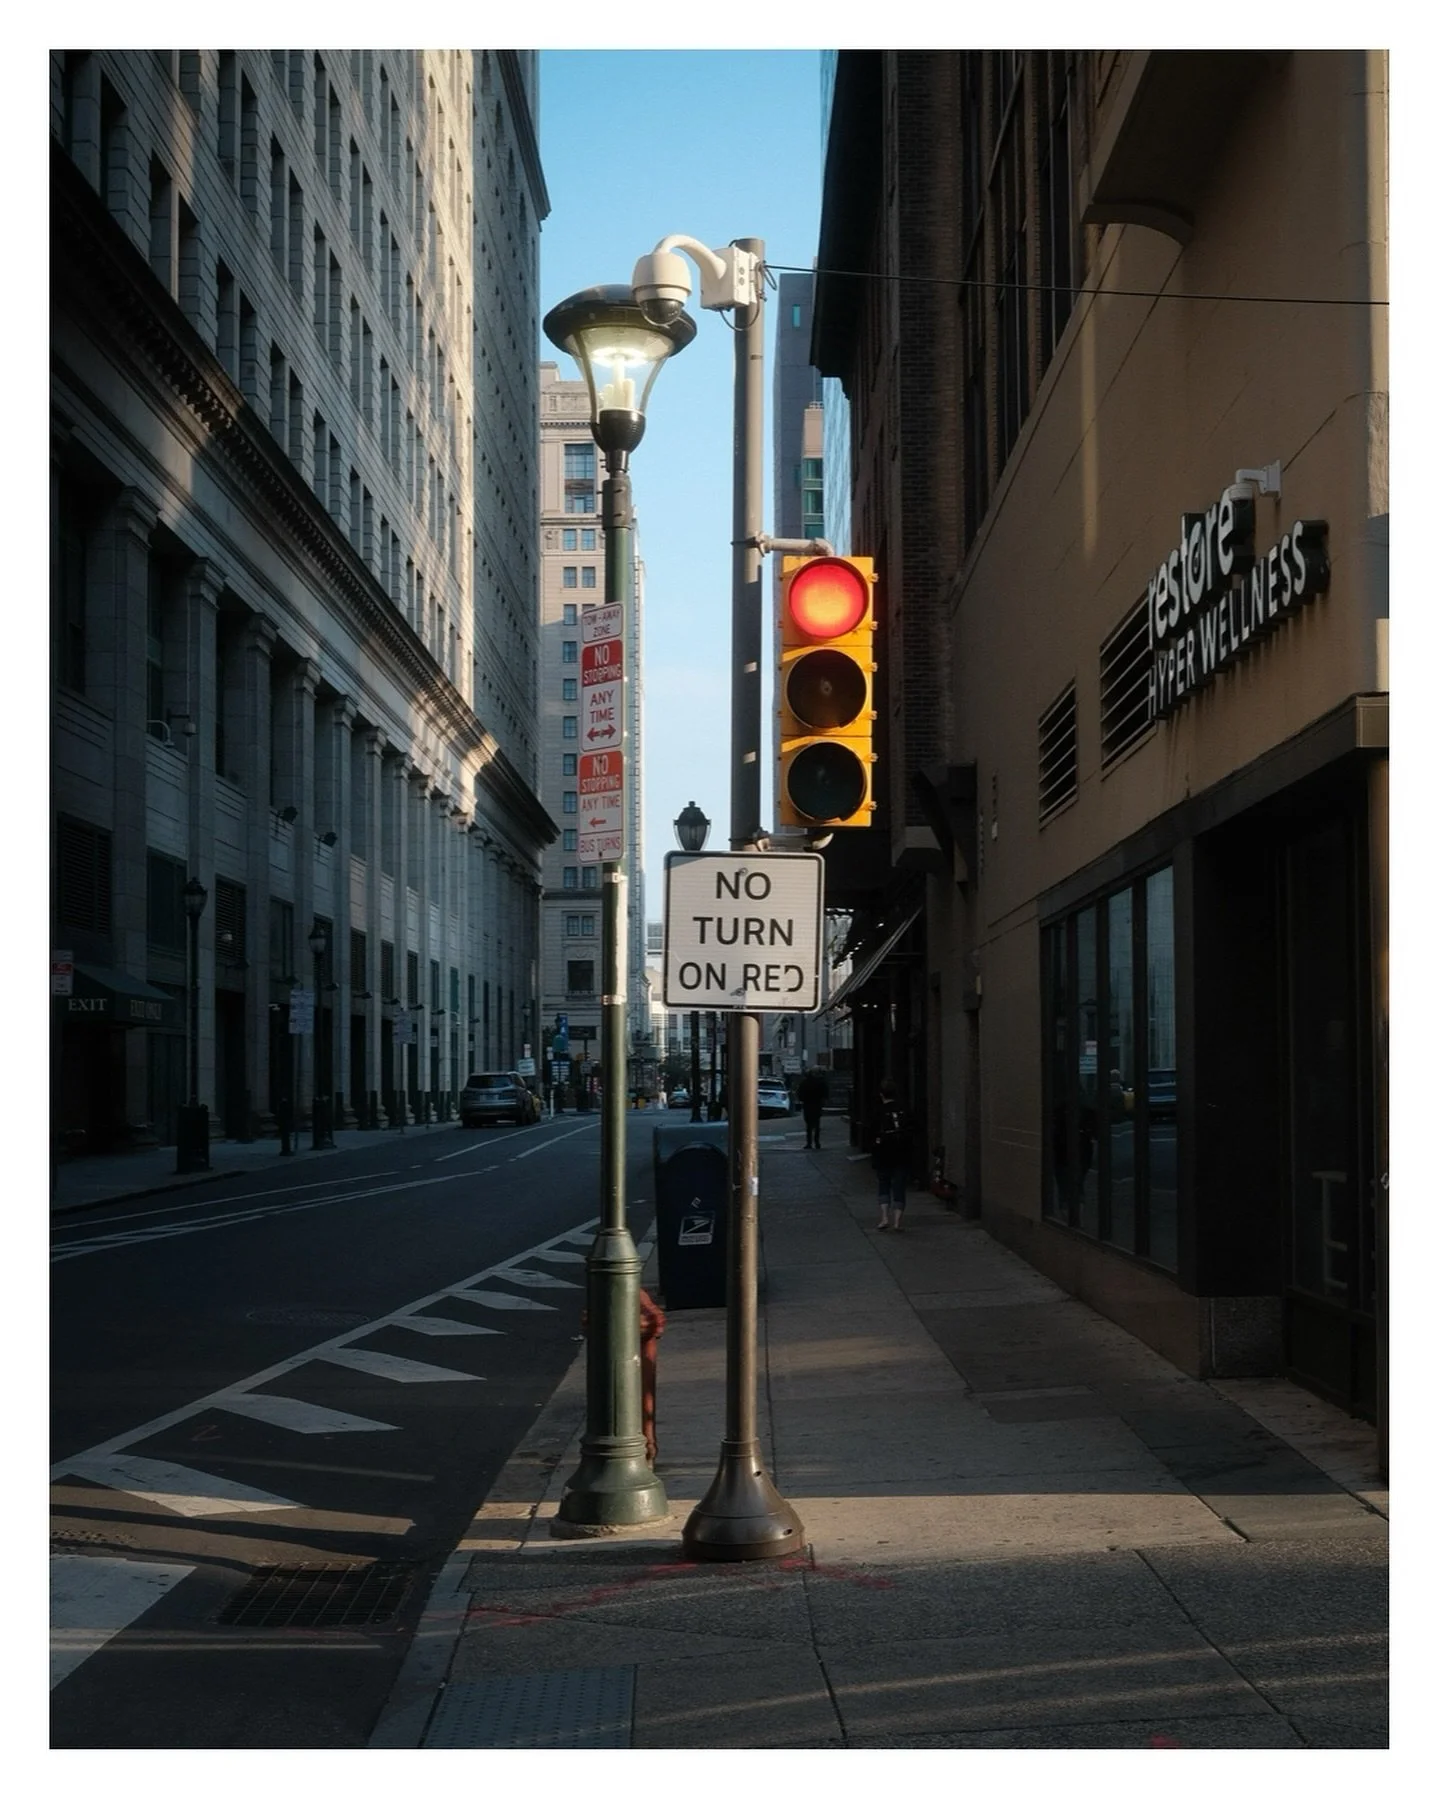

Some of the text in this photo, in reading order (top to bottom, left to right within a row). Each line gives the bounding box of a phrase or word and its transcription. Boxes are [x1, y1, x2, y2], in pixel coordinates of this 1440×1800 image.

[1149, 484, 1235, 650] restore
[1149, 520, 1306, 717] HYPER WELLNESS
[593, 623, 610, 638] ZONE
[594, 644, 610, 667] NO
[583, 663, 622, 684] STOPPING
[590, 688, 615, 707] ANY
[590, 707, 615, 724] TIME
[592, 754, 609, 776] NO
[581, 774, 620, 793] STOPPING
[581, 795, 620, 812] ANY TIME
[716, 871, 771, 900] NO
[692, 917, 793, 946] TURN
[679, 961, 804, 992] ON RED
[67, 998, 108, 1012] EXIT
[130, 999, 145, 1018] EXIT
